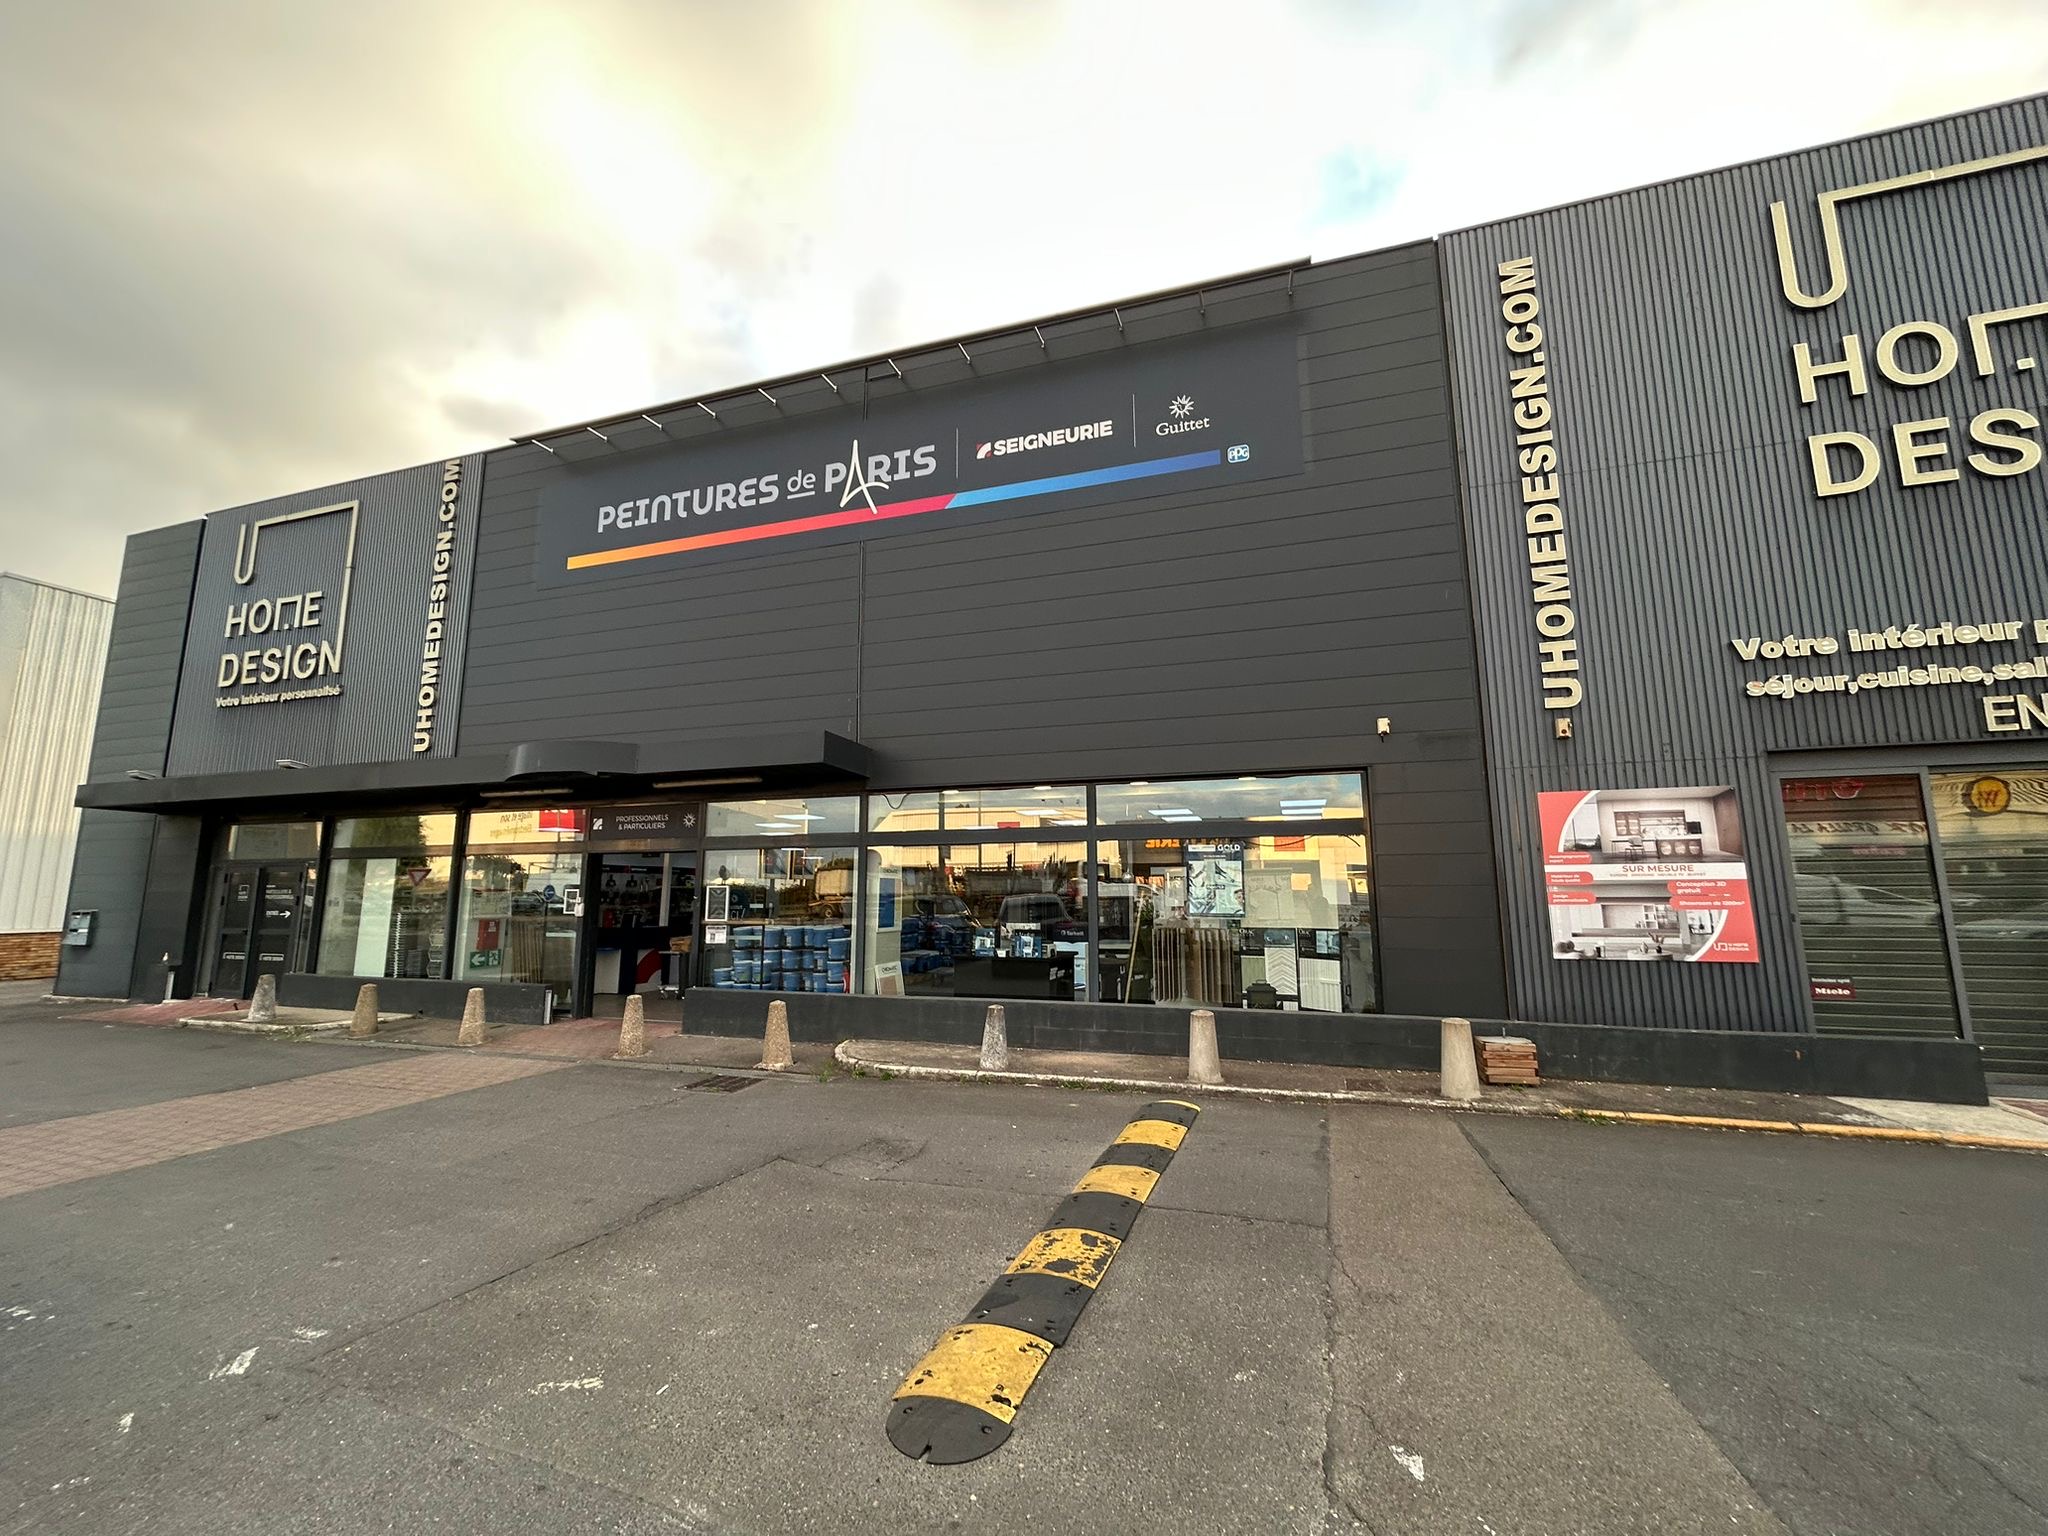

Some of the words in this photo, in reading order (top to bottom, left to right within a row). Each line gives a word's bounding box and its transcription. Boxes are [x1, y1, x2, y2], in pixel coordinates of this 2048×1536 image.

[993, 420, 1114, 456] SEIGNEURIE
[1156, 416, 1210, 436] Guittet
[1228, 445, 1250, 463] PPG
[1808, 408, 2042, 497] DES
[597, 474, 779, 533] PEINTURES
[787, 469, 816, 500] de
[824, 440, 936, 514] PARIS
[1498, 256, 1583, 709] UHOMEDESIGN.COM
[224, 590, 323, 638] HOME
[413, 458, 460, 752] UHOMEDESIGN.COM
[1732, 635, 1839, 661] Votre
[1848, 620, 2023, 653] intérieur
[217, 640, 341, 688] DESIGN
[1746, 656, 2048, 699] séjour,cuisine,sal
[216, 697, 240, 708] Votre
[240, 692, 280, 705] intérieur
[615, 814, 669, 823] PROFESSIONNELS
[618, 823, 623, 831] &
[623, 822, 666, 831] PARTICULIERS
[1622, 865, 1645, 873] SUR
[1647, 864, 1695, 873] MESURE
[1815, 987, 1850, 995] Miele
